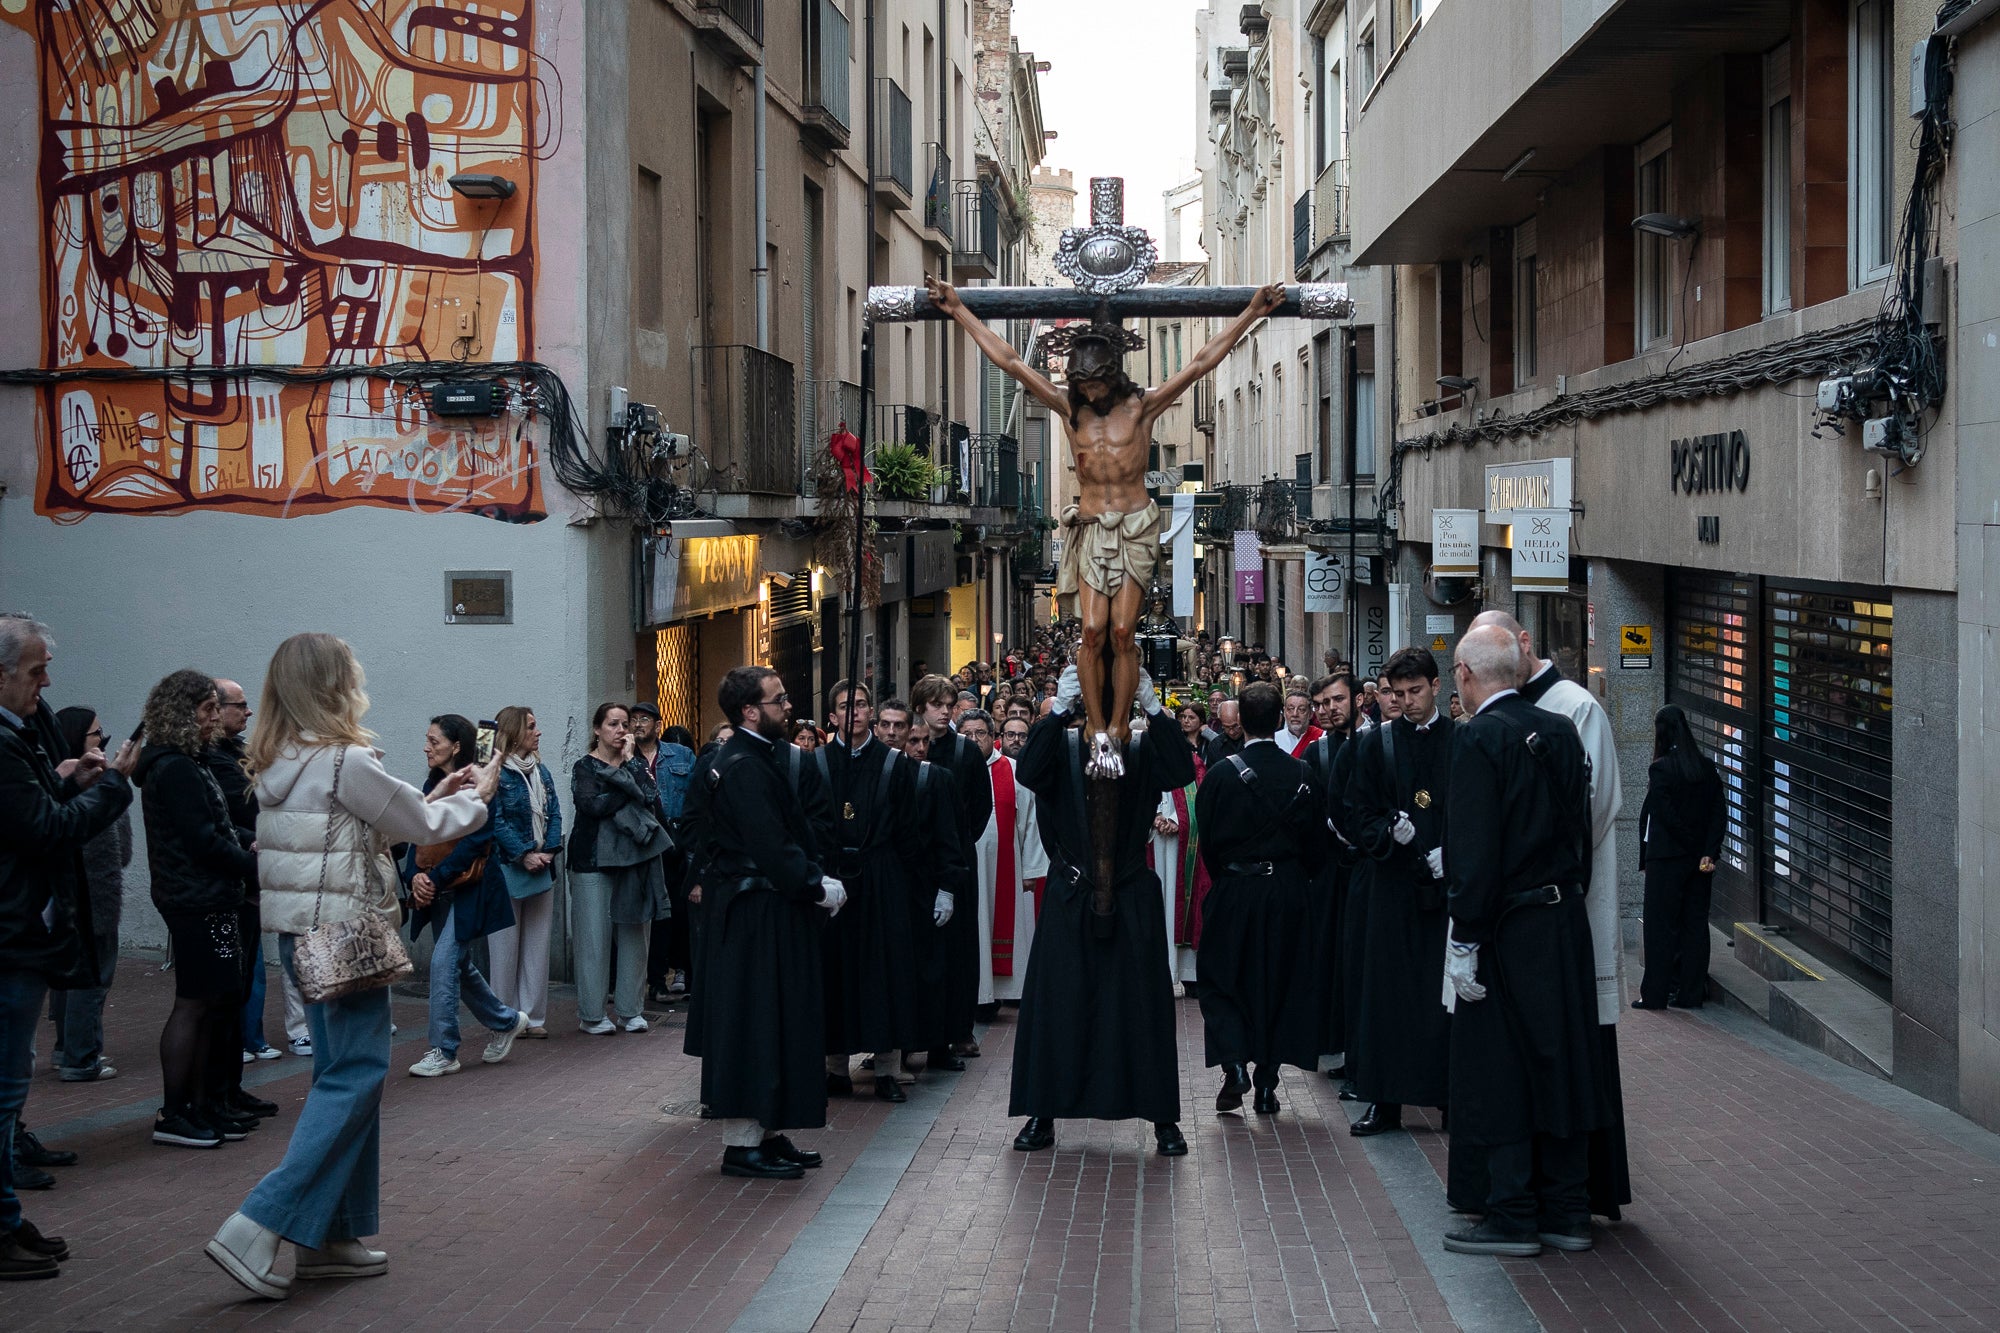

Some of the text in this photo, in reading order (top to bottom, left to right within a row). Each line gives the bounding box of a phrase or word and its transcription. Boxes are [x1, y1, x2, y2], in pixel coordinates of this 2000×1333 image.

[1670, 429, 1750, 494] POSITIVO
[1499, 477, 1525, 510] HELLO
[1452, 540, 1472, 549] uñas
[1524, 539, 1560, 548] HELLO
[1439, 550, 1473, 558] de moda!
[1518, 550, 1566, 563] NAILS
